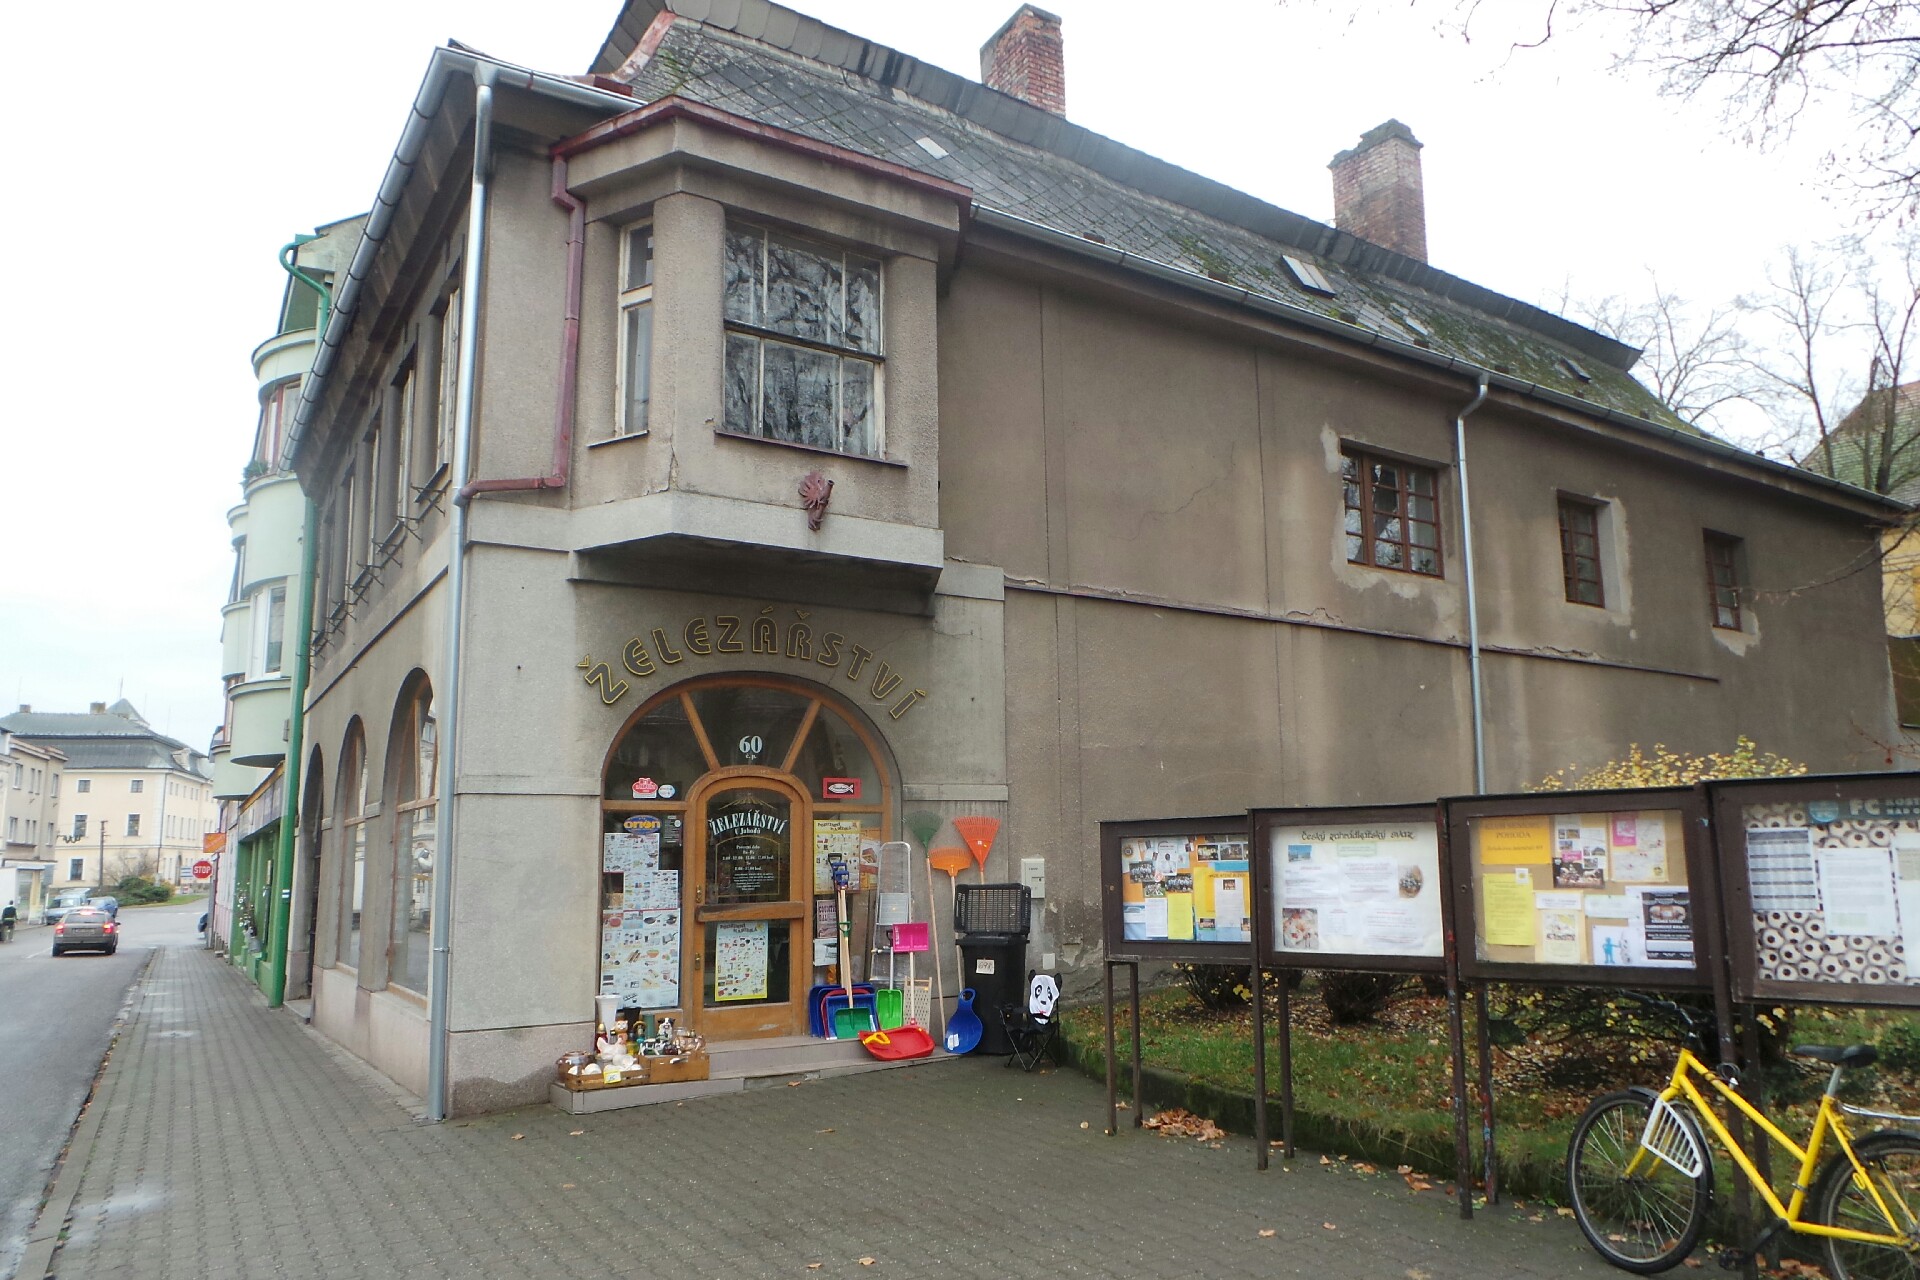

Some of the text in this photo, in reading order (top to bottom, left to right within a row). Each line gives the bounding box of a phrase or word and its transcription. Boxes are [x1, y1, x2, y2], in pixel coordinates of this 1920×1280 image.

[576, 605, 927, 720] ŽELEZÁŘSTVÍ
[739, 735, 763, 754] 60
[1849, 799, 1881, 816] FC
[707, 808, 788, 836] ŽELEZÁŘSTVÍ
[1301, 830, 1326, 841] Český
[193, 866, 210, 874] STOP
